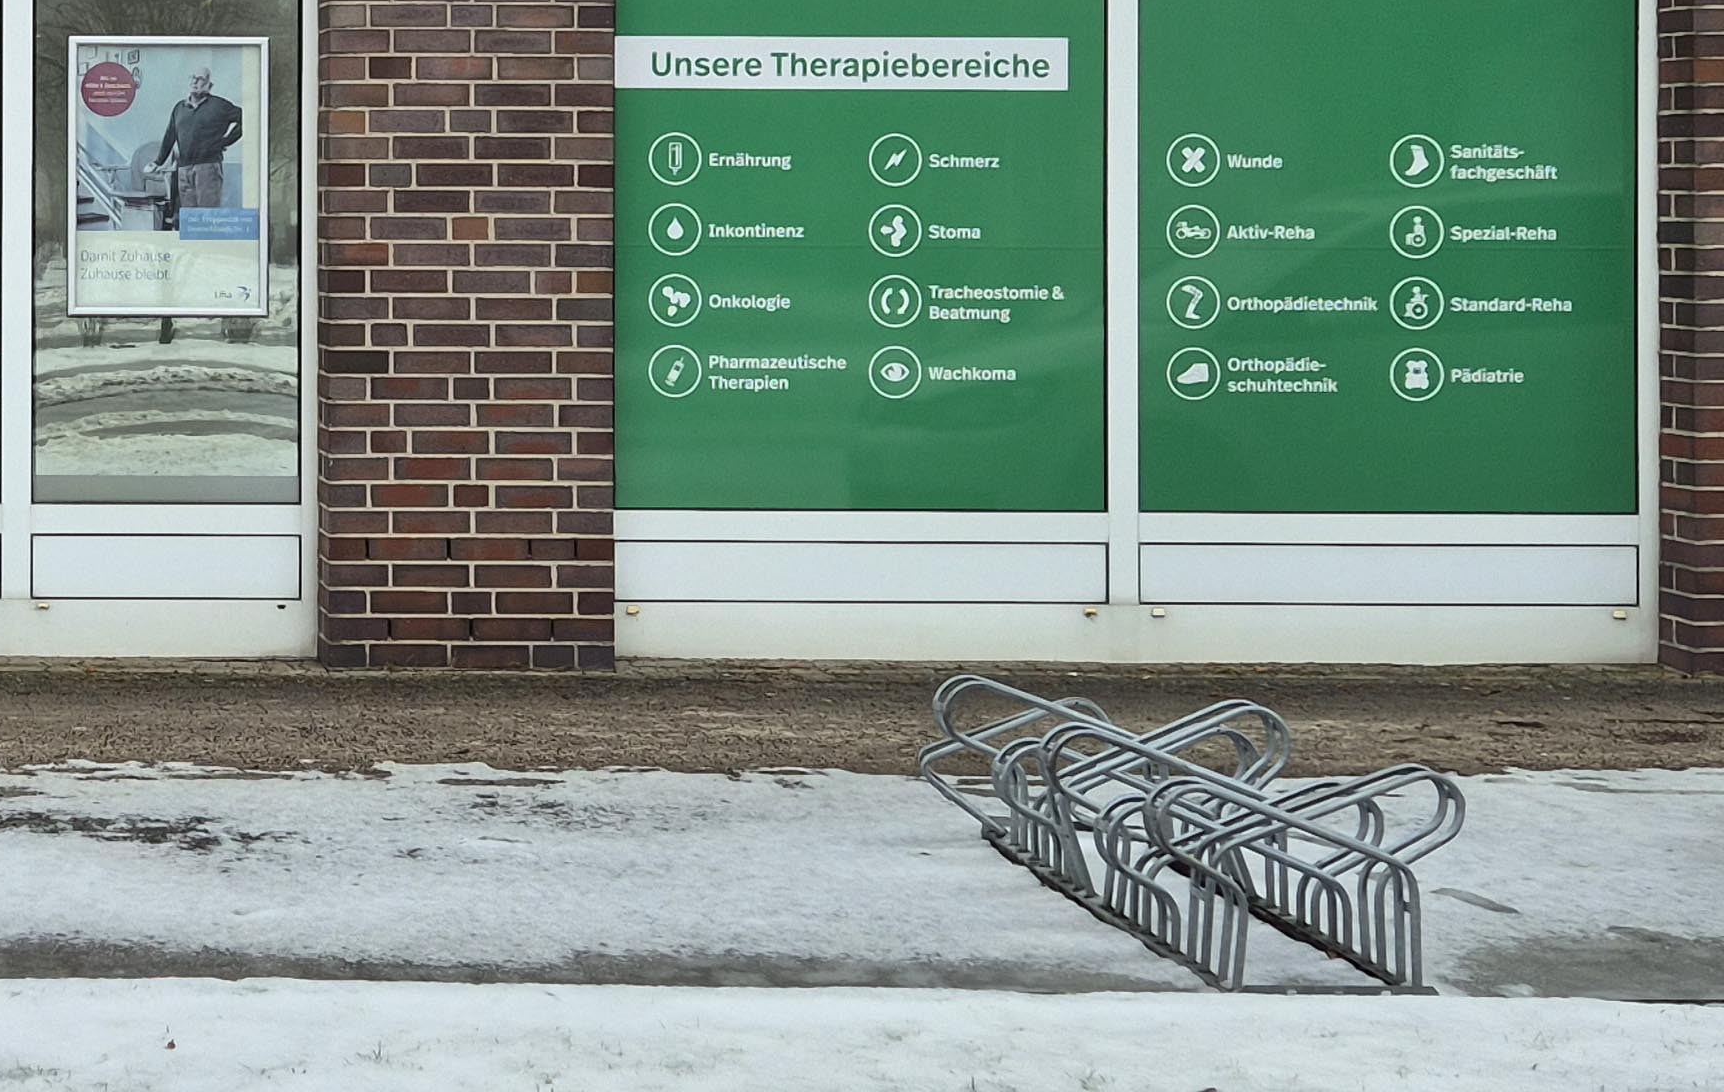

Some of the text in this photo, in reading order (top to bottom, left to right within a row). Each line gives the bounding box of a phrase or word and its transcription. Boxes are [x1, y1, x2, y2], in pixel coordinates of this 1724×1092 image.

[652, 51, 1049, 82] Unsere Therapiebereiche
[1451, 144, 1524, 158] Sanitäts-
[709, 153, 791, 170] Ernährung
[930, 154, 999, 168] Schmerz
[1228, 154, 1282, 168] Wunde
[1451, 165, 1557, 182] fachgeschäft
[709, 224, 804, 237] Inkontinenz
[929, 225, 980, 238] Stoma
[1227, 225, 1314, 239] Aktiv-Reha
[1451, 226, 1556, 242] Spezial-Reha
[80, 250, 171, 263] Damit Zuhause
[80, 268, 132, 280] Zuhause
[929, 285, 1064, 301] Tracheostomie &
[709, 294, 790, 311] Onkologie
[1227, 297, 1377, 313] Orthopädietechnik
[1451, 297, 1572, 311] Standard-Reha
[930, 306, 1010, 323] Beatmung
[709, 355, 846, 369] Pharmazeutische
[1227, 357, 1326, 375] Orthopädie-
[929, 367, 1015, 380] Wachkoma
[1451, 368, 1523, 382] Pädiatrie
[709, 375, 788, 392] Therapien
[1228, 378, 1337, 392] schuhtechnik
